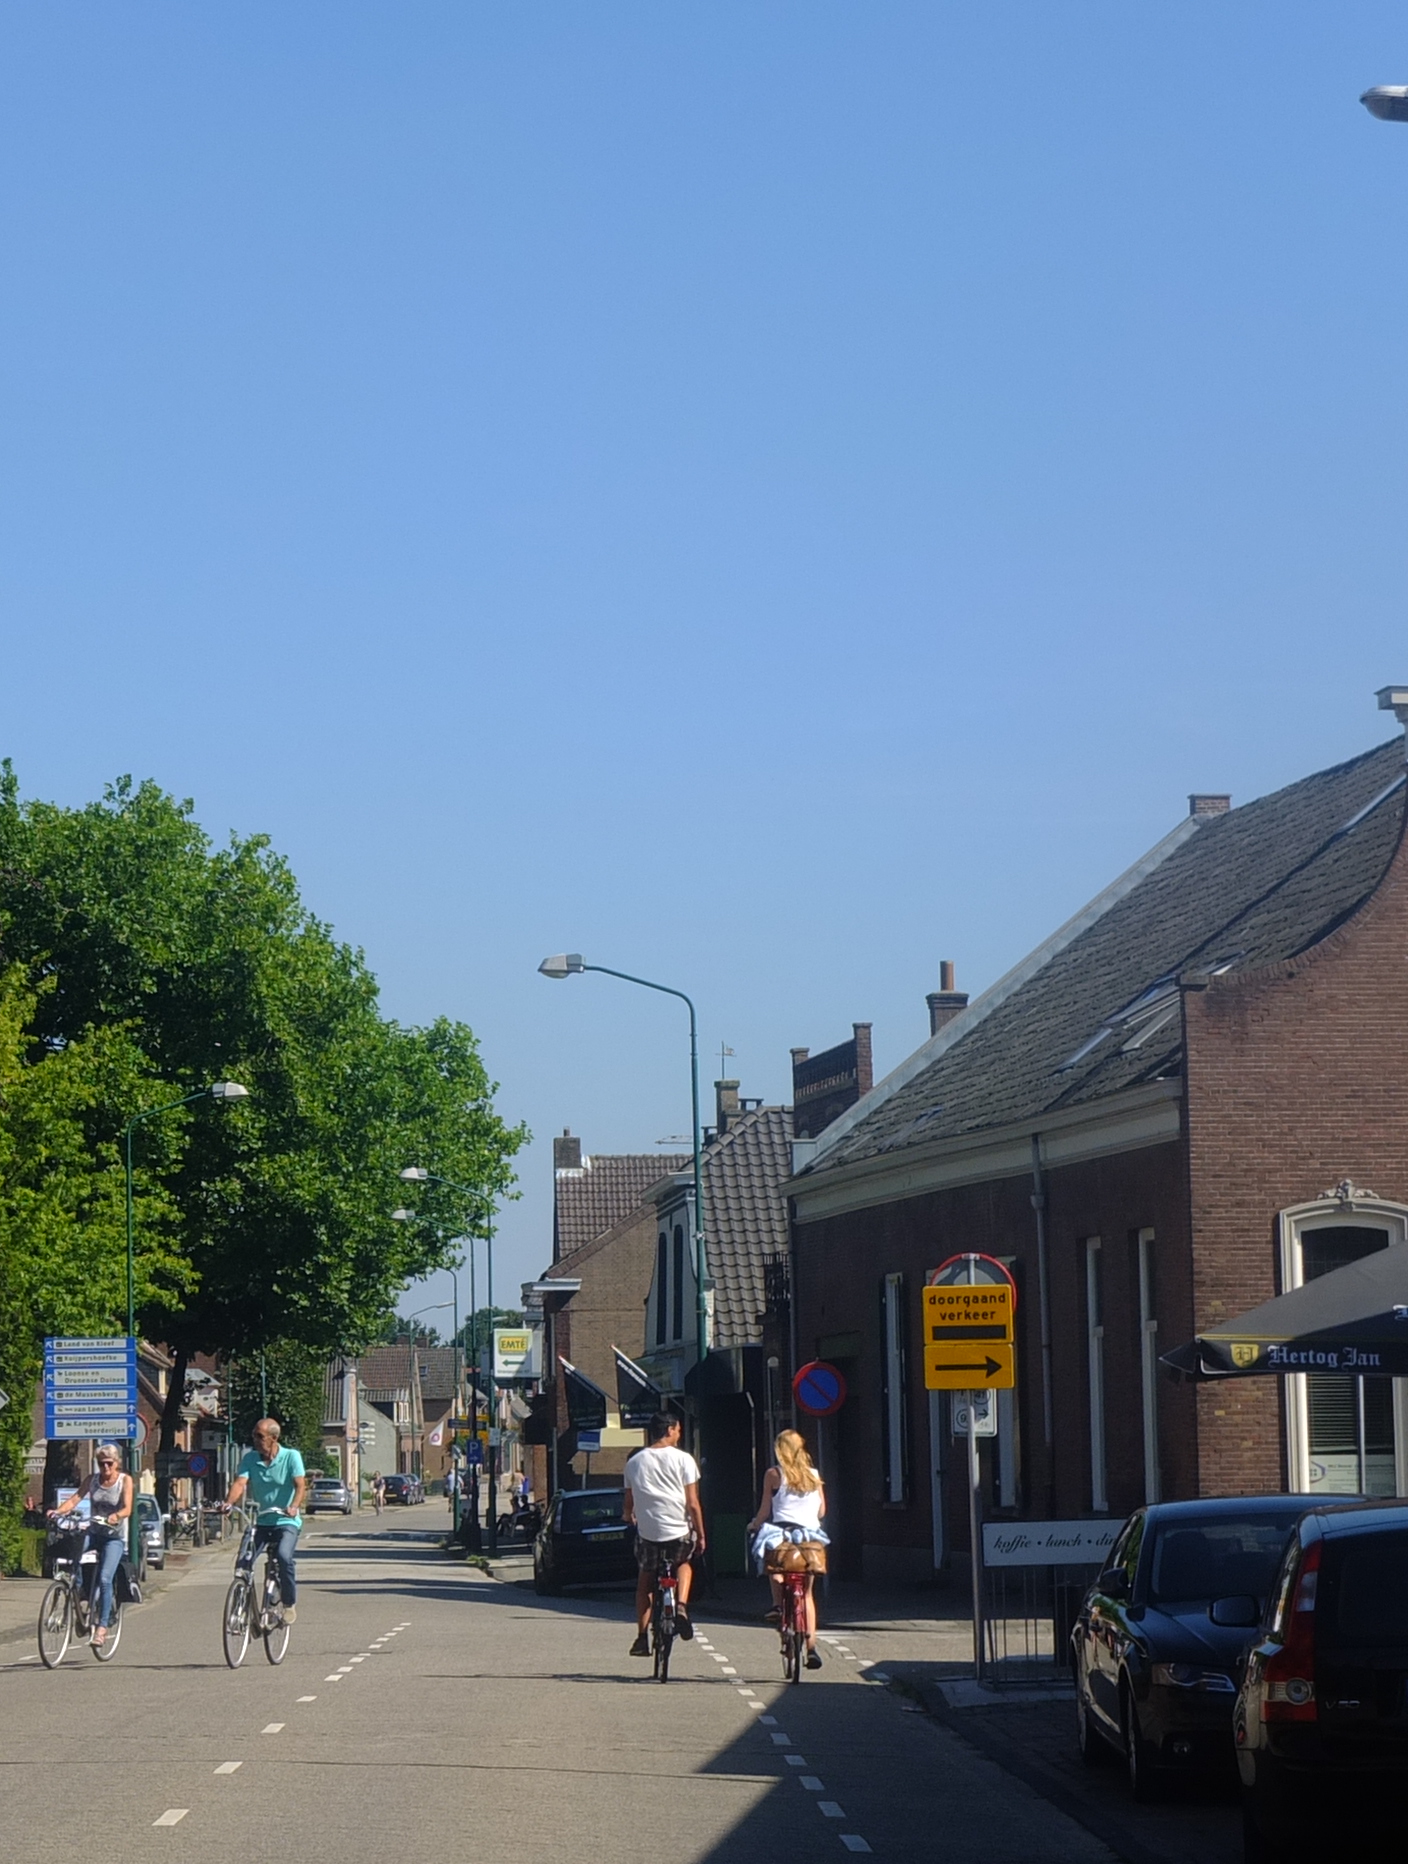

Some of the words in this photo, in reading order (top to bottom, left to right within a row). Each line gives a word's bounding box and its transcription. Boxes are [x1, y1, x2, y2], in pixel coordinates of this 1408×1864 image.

[928, 1293, 1006, 1307] doorgaand
[939, 1310, 996, 1320] verkeer
[500, 1337, 526, 1349] EMTÉ
[1267, 1345, 1339, 1368] Hertog
[1342, 1346, 1381, 1368] Jan
[993, 1535, 1031, 1554] koffie
[1045, 1533, 1082, 1548] lunch
